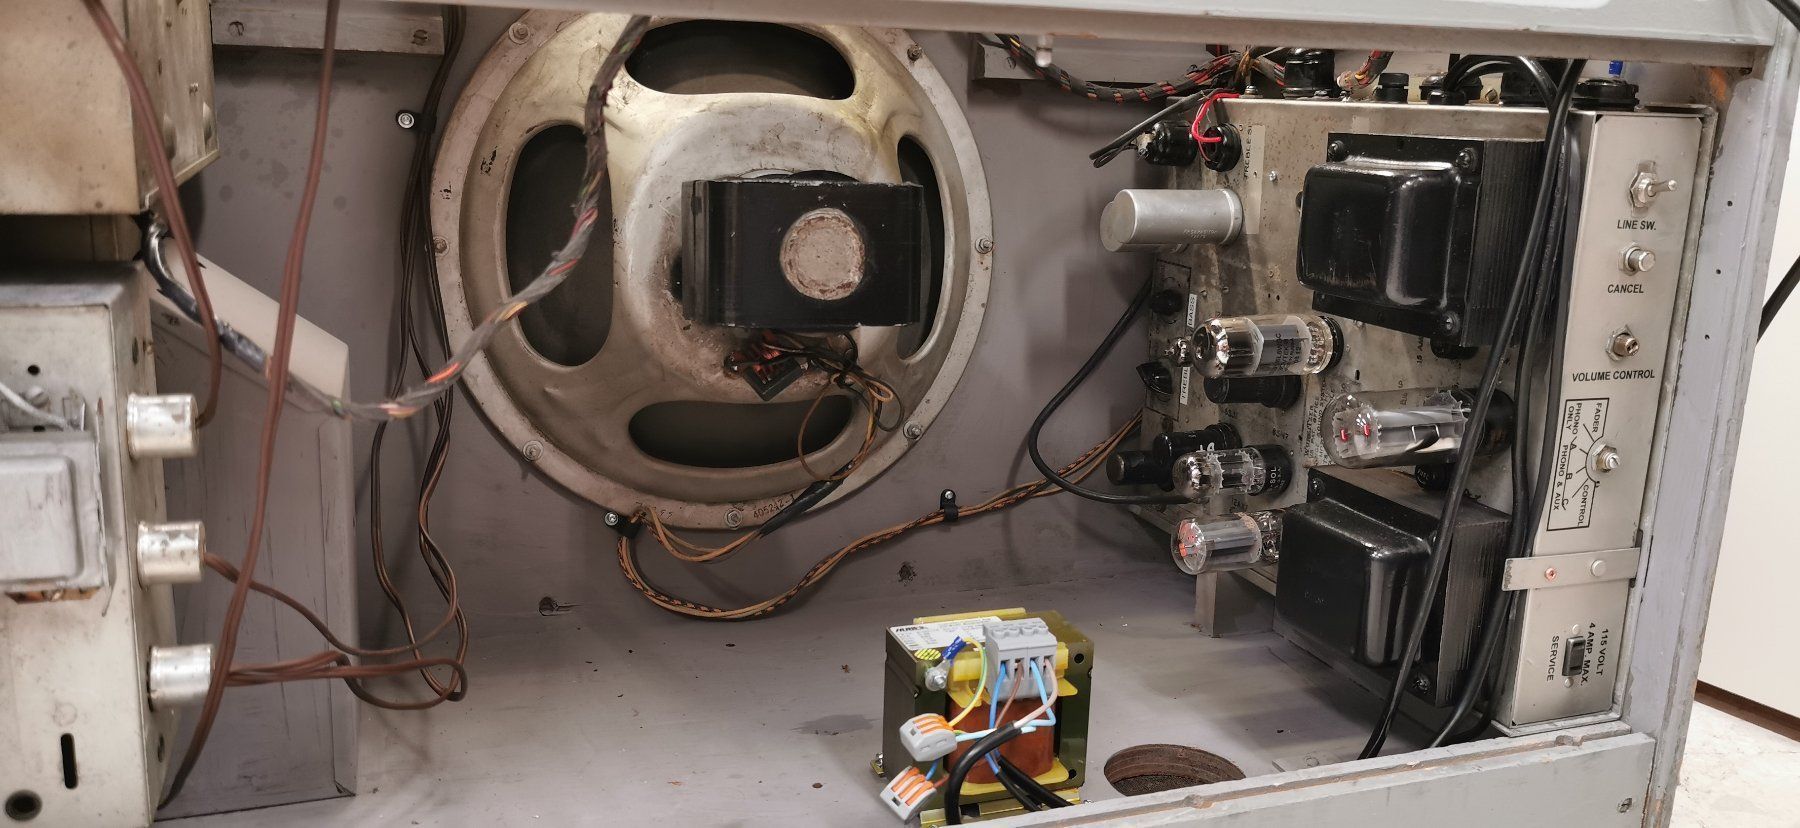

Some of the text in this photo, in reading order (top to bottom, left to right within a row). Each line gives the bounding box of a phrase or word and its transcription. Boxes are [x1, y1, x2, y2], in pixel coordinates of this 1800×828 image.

[1617, 219, 1657, 231] LINE SW.
[1607, 284, 1645, 294] CANCEL
[1187, 297, 1196, 326] BASS
[1572, 369, 1656, 382] VOLUME CONTROL
[1566, 405, 1575, 430] ONLY
[1572, 402, 1582, 435] PHONO
[1591, 402, 1602, 433] FADER
[1558, 445, 1568, 477] PHONO
[1553, 492, 1561, 510] AUX
[1577, 484, 1589, 527] CONTROL
[1547, 635, 1560, 682] SERVICE
[1596, 629, 1609, 676] 115 VOLT
[1580, 660, 1591, 686] MAX.
